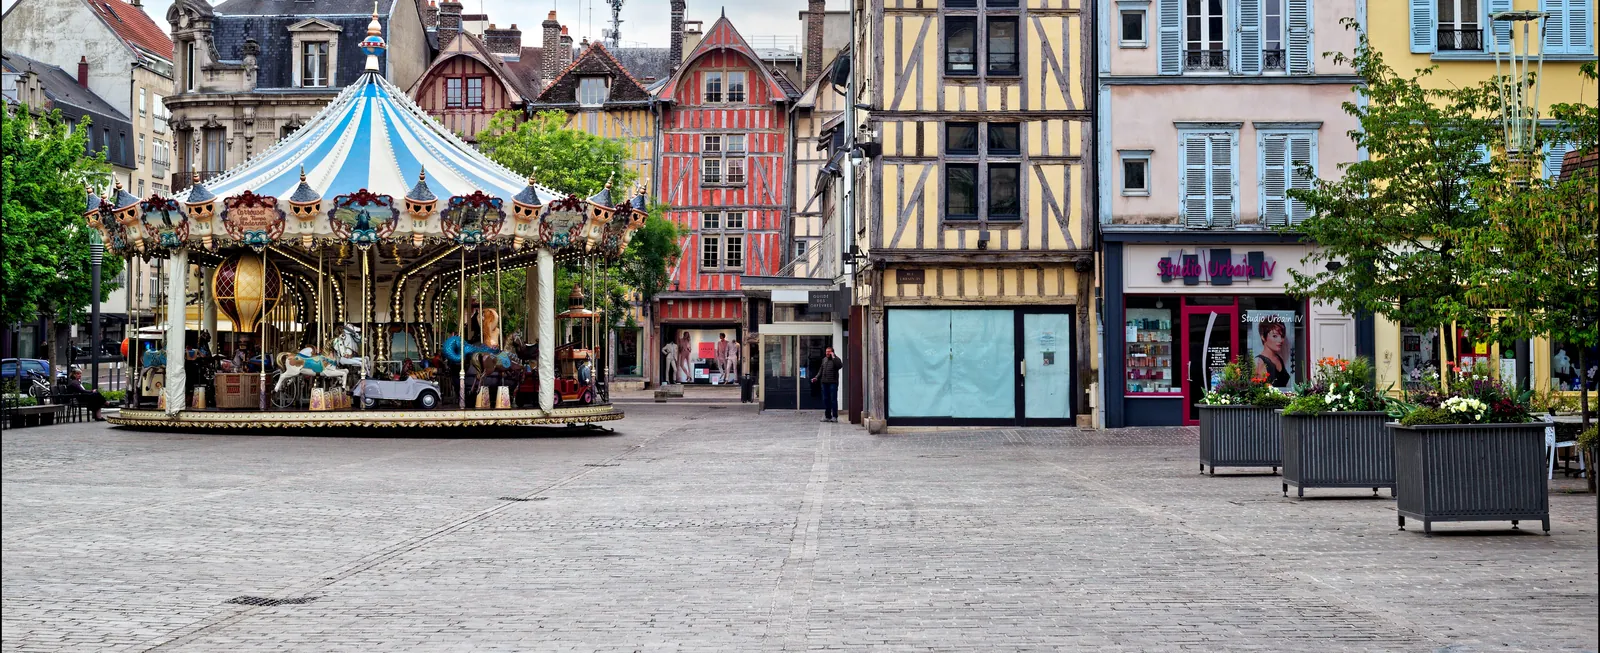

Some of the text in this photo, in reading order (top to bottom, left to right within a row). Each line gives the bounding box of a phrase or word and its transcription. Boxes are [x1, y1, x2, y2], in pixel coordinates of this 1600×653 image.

[1156, 258, 1277, 277] Studio Urbain IV
[1241, 313, 1304, 323] Studio Urbain IV
